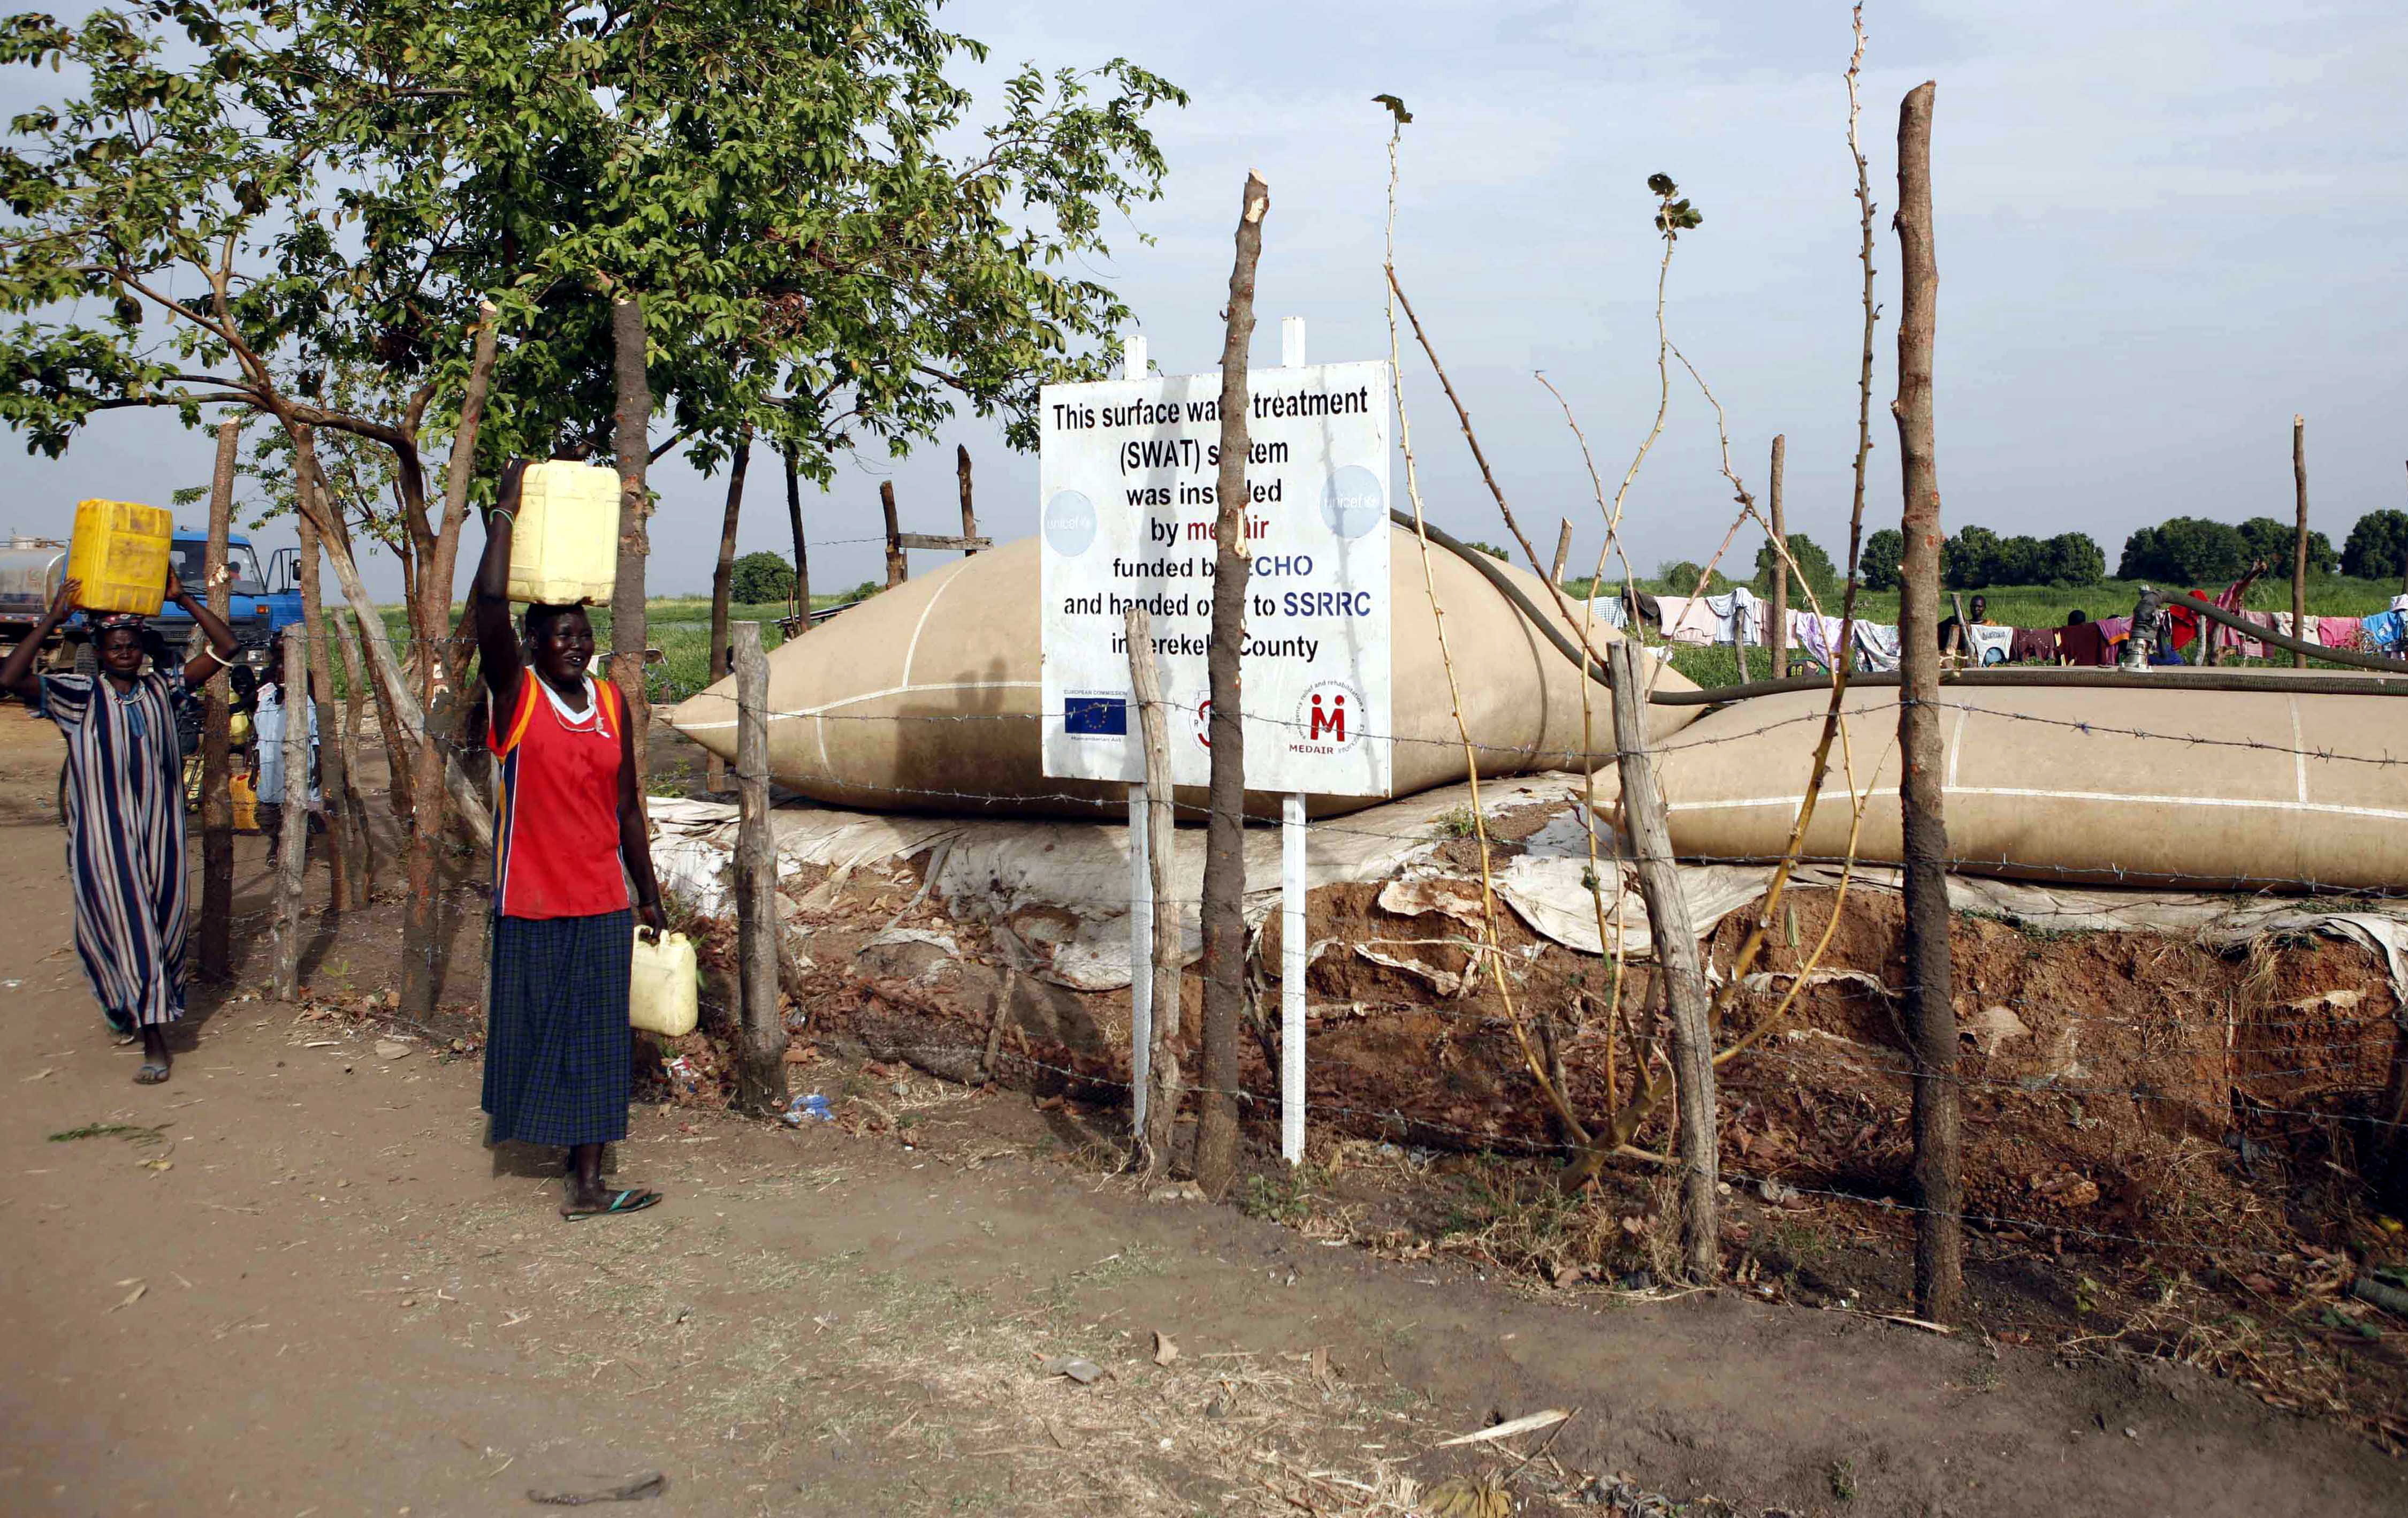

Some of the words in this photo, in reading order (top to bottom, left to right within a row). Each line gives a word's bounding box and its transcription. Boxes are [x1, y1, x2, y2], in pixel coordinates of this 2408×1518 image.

[1053, 403, 1095, 430] This
[1102, 398, 1179, 427] surface
[1253, 386, 1367, 419] treatment
[1121, 439, 1200, 476] (SWAT)
[1208, 441, 1287, 466] stem
[1126, 487, 1171, 506] was
[1180, 479, 1281, 505] insled
[1151, 517, 1178, 547] by
[1113, 557, 1193, 578] funded
[1202, 557, 1215, 577] b
[1248, 555, 1313, 576] CHO
[1064, 593, 1101, 614] and
[1110, 593, 1188, 616] handed
[1254, 594, 1276, 616] to
[1284, 591, 1370, 617] SSRRC
[1112, 633, 1128, 654] in
[1240, 635, 1319, 663] County
[1315, 680, 1326, 688] and
[1289, 744, 1334, 754] MEDAIR
